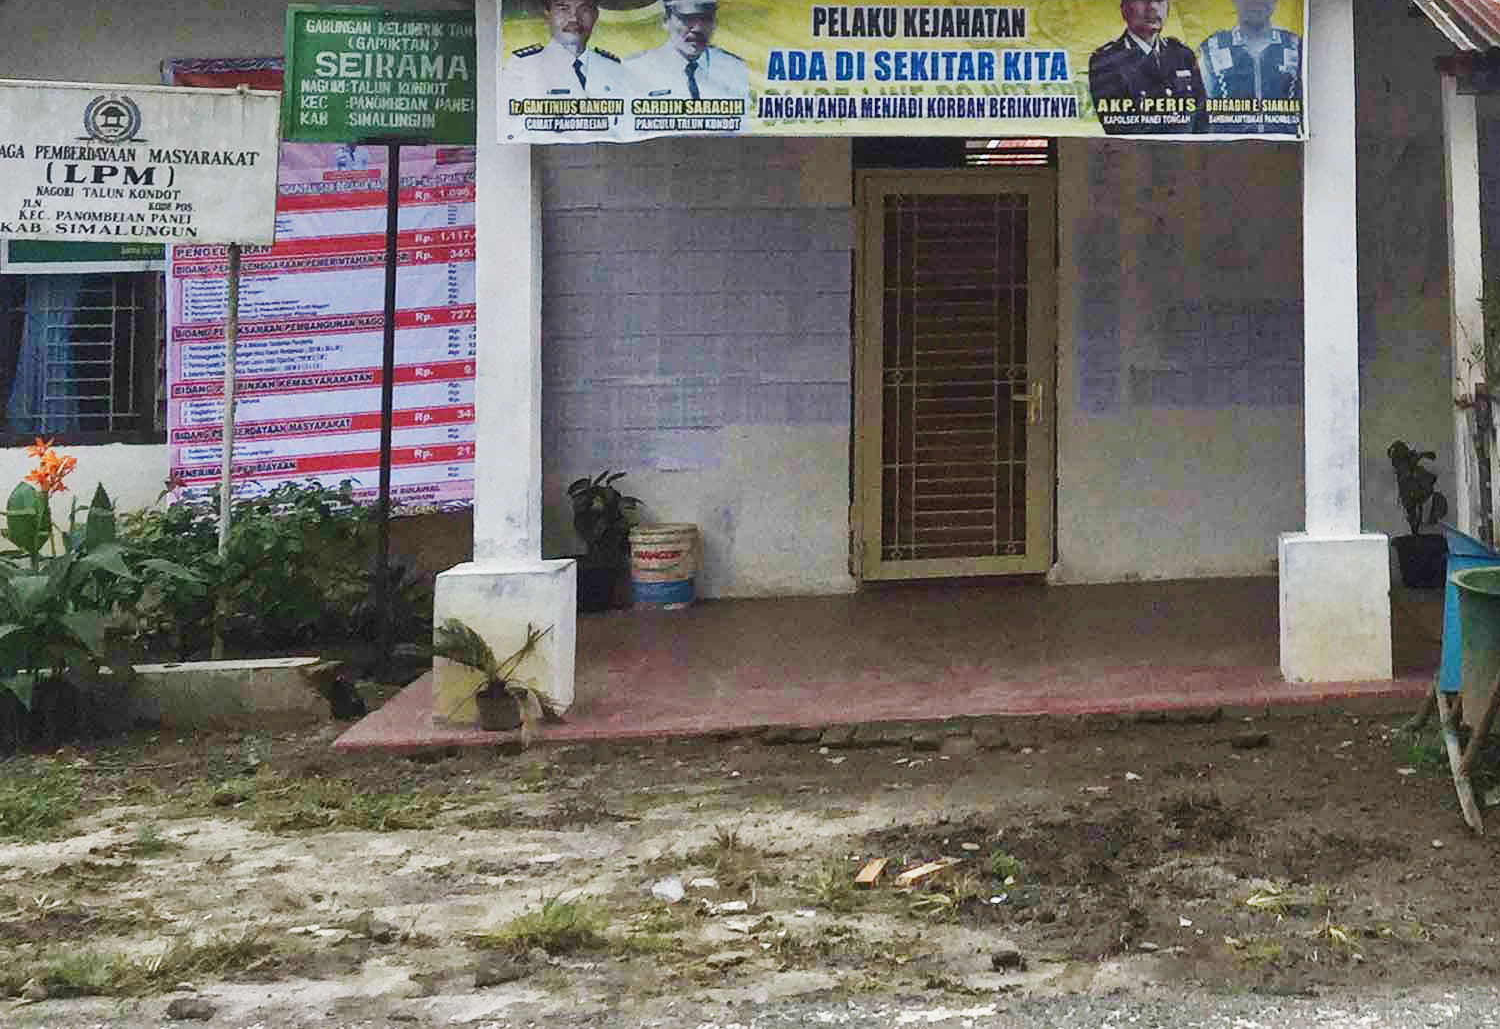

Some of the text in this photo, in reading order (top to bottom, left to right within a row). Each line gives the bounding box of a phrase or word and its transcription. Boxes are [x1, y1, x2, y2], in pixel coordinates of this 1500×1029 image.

[306, 19, 372, 35] GABUNGAN
[813, 7, 1026, 38] PELAKU KEJAHATAN
[315, 51, 469, 80] SEIRAMA
[767, 49, 1069, 82] ADA DI SEKITAR KITA
[301, 95, 328, 109] KEC
[632, 99, 744, 115] SARDIN SARAGIH
[758, 96, 1078, 119] JANGAN ANDA MENJADI KORBAN BERIKUTNYA
[1206, 98, 1251, 112] BRIGADIR
[301, 111, 328, 126] KAB
[35, 145, 136, 162] PEMBERDAYAAN
[149, 149, 259, 166] MASYARAKAT
[82, 187, 124, 198] TALUN
[129, 189, 181, 200] KONDOT
[56, 210, 145, 222] PANOMBEIAN
[152, 213, 191, 224] PANEI
[56, 222, 197, 237] SIMALUNGUN
